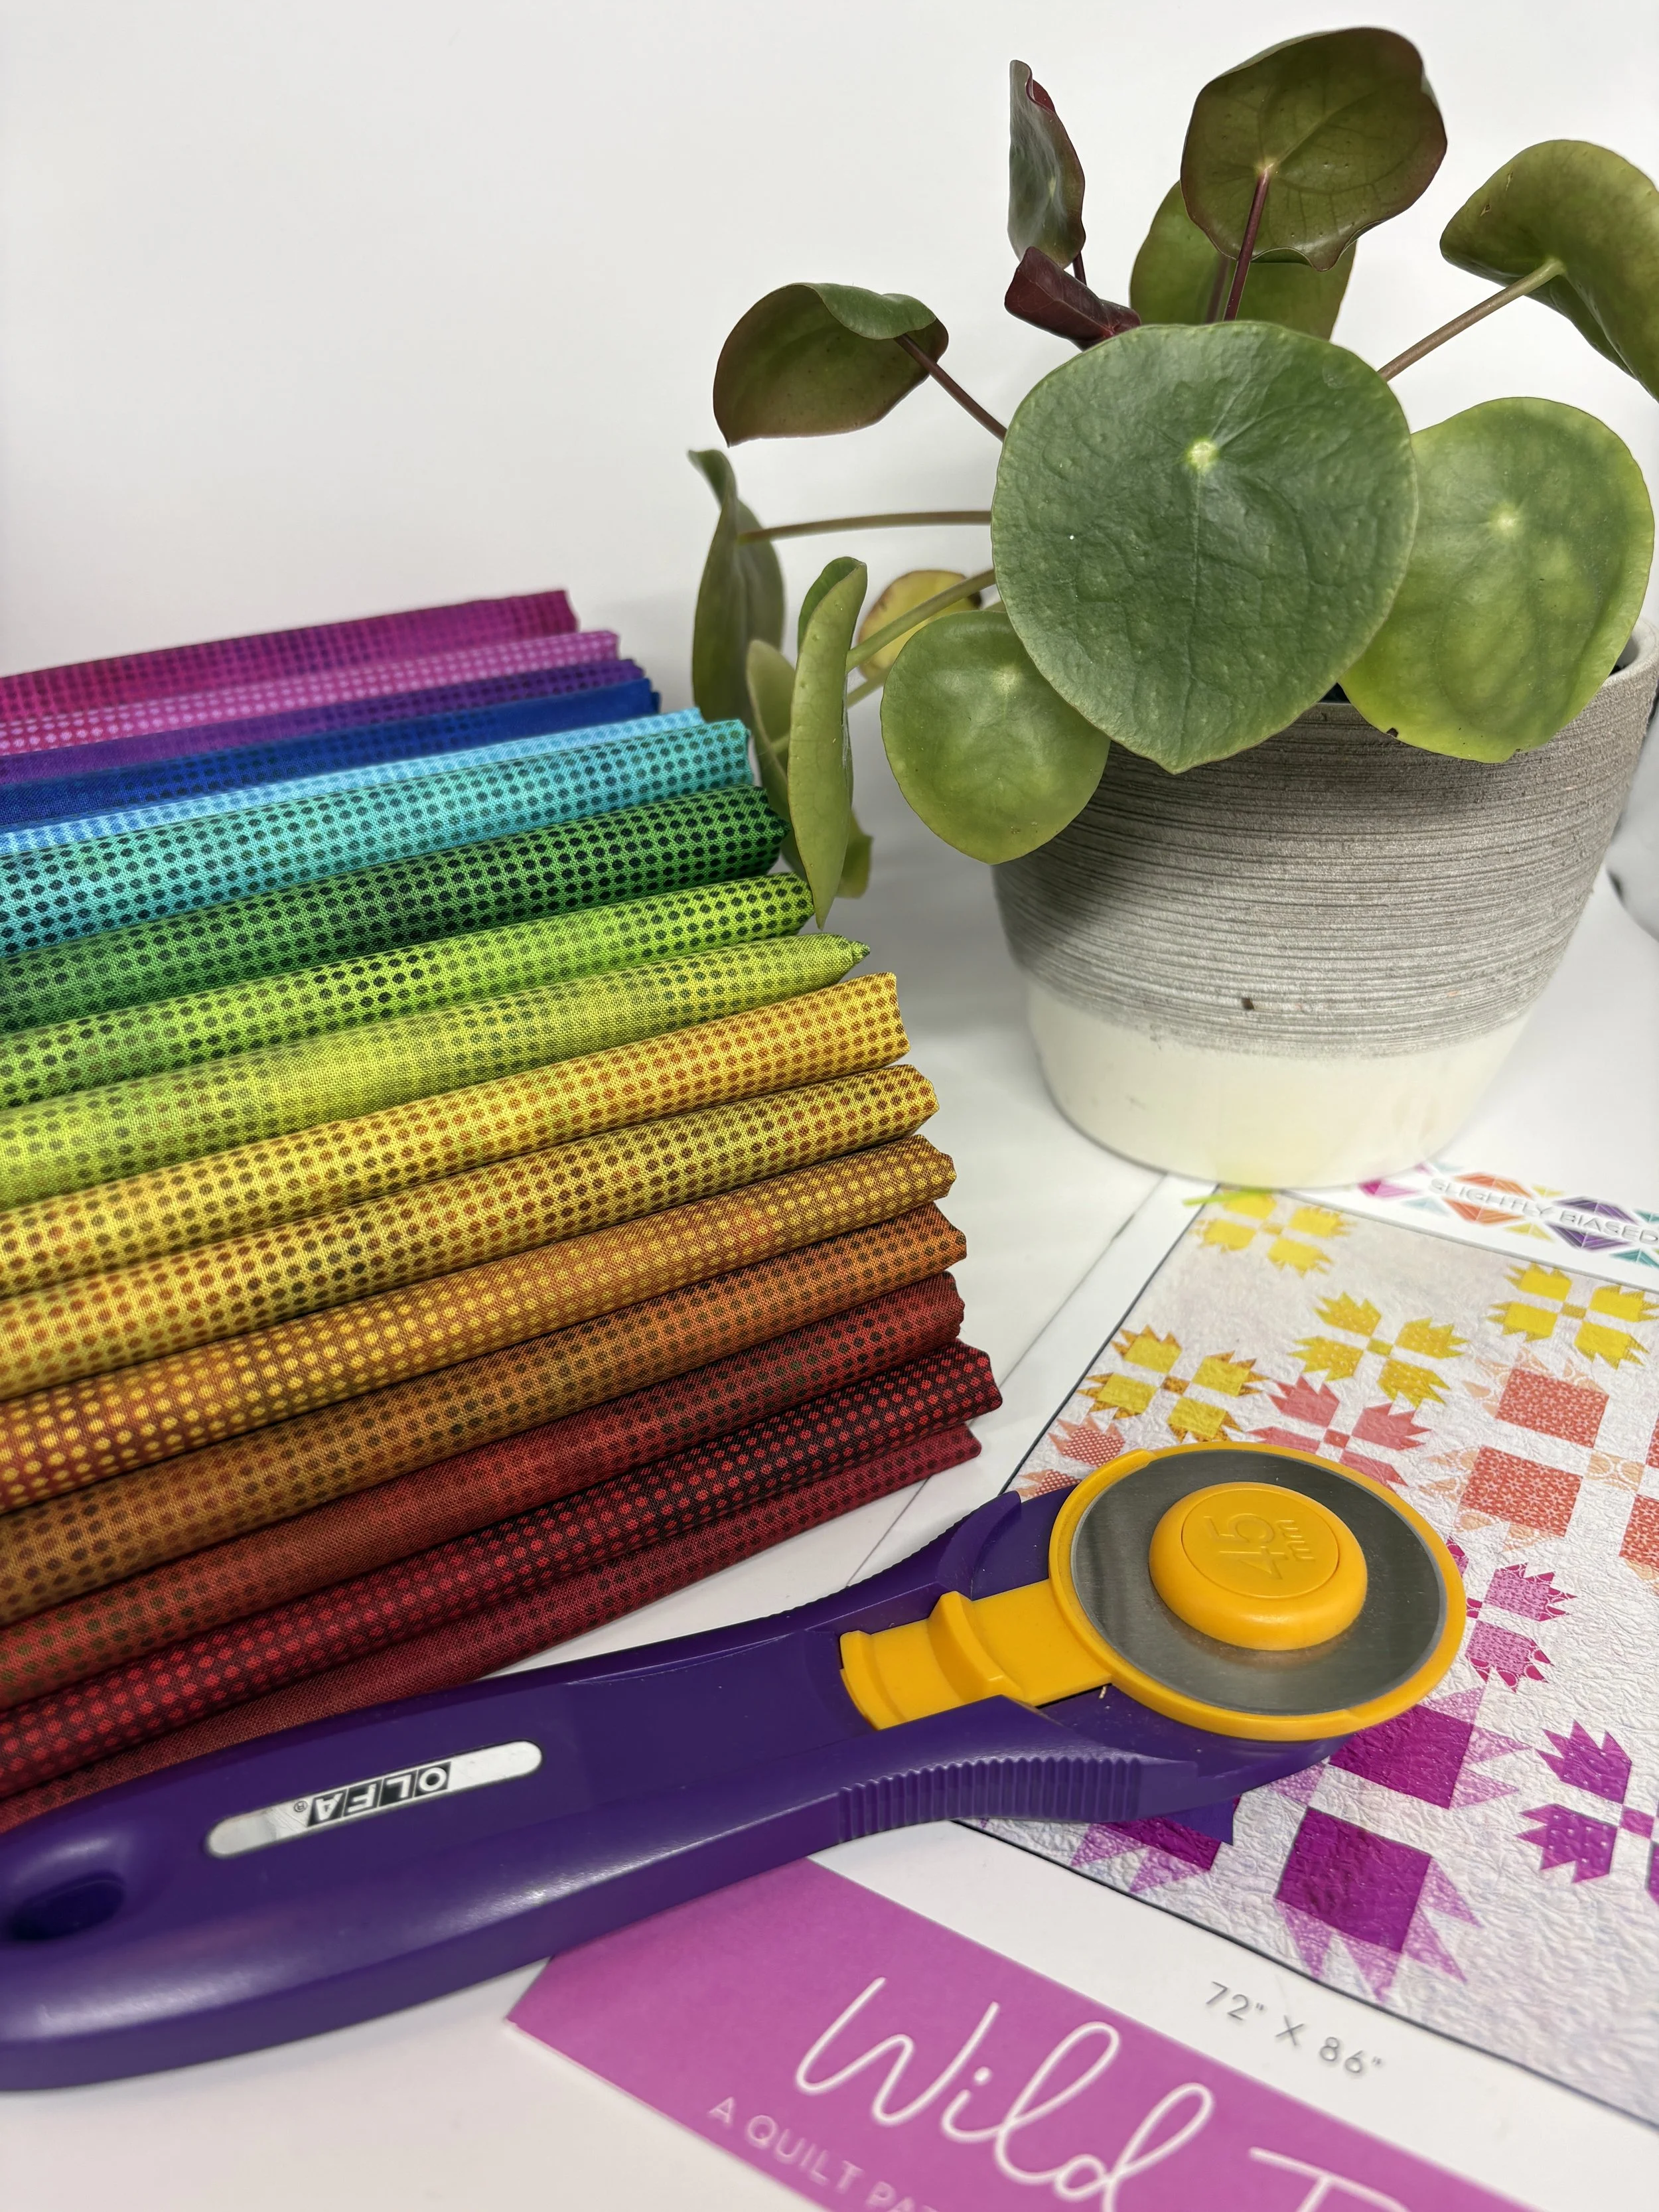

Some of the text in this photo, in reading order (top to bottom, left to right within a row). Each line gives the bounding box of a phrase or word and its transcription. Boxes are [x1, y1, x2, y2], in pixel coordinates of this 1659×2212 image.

[1428, 1177, 1659, 1245] SLIGHTLY BIASED
[795, 1976, 1214, 2212] Wild
[707, 2096, 735, 2126] A
[745, 2114, 865, 2193] QUILT
